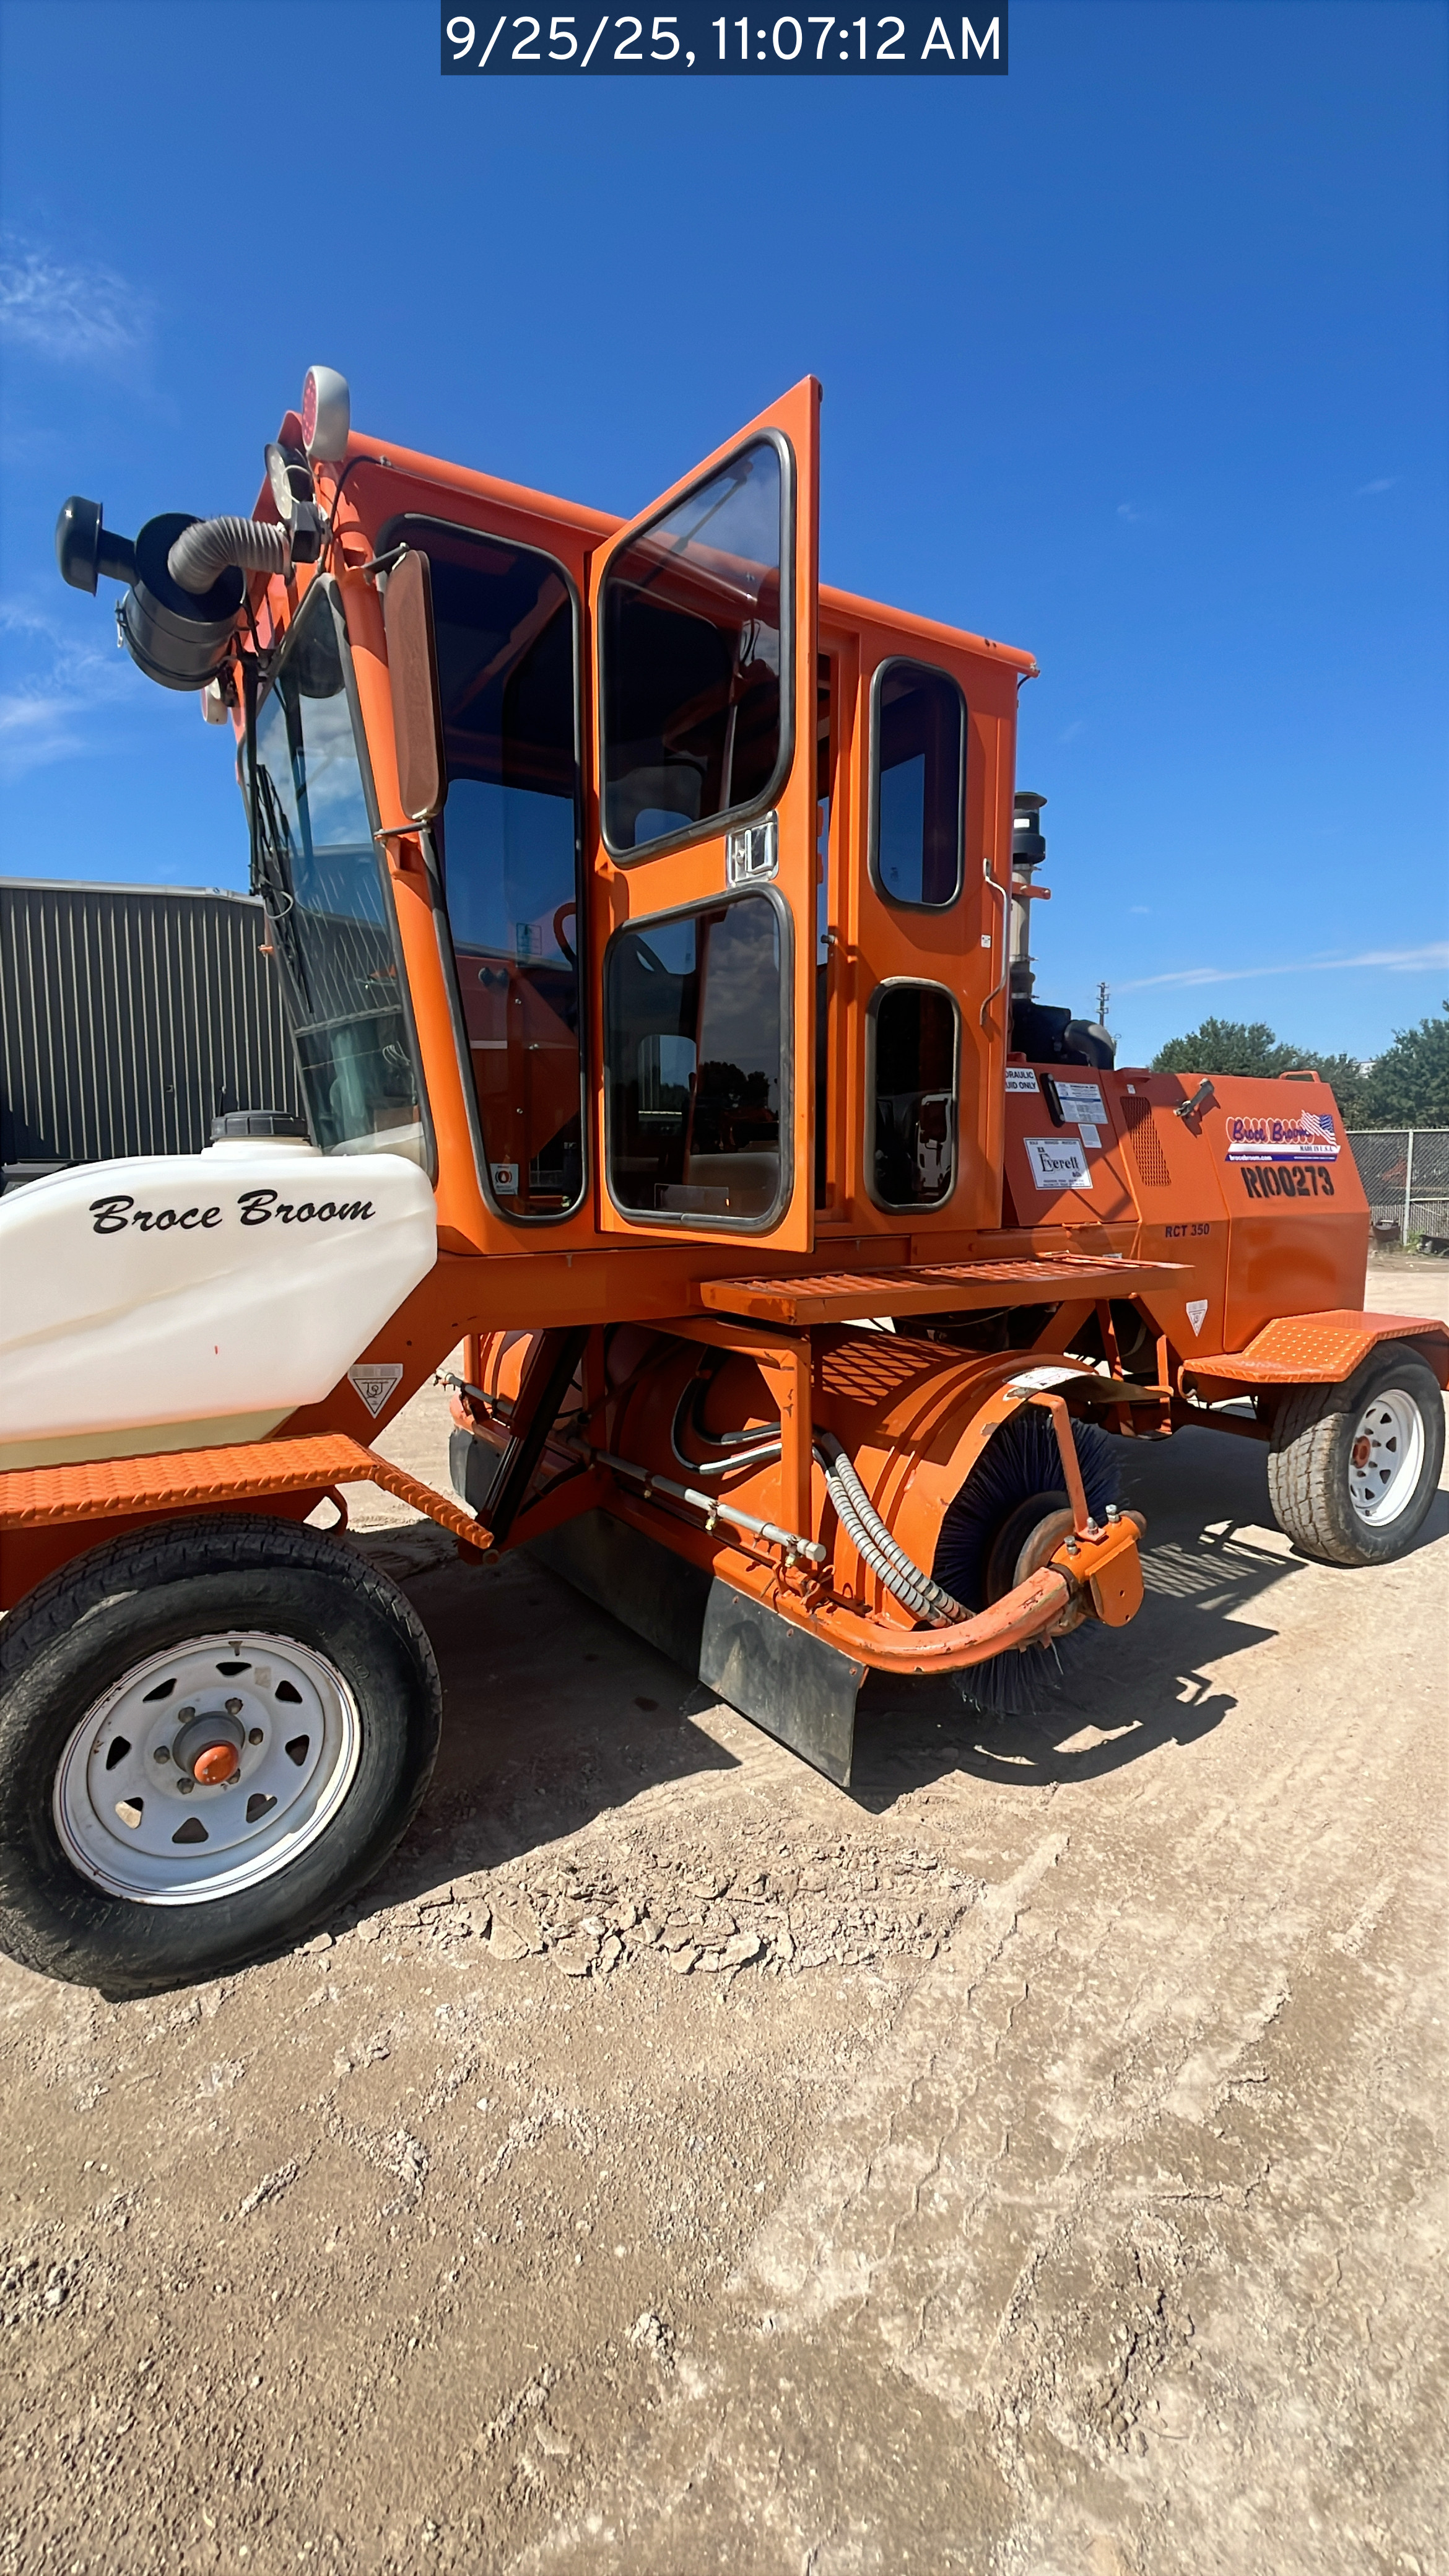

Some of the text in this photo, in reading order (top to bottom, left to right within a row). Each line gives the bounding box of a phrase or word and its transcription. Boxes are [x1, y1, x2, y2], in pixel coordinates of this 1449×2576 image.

[1006, 1071, 1033, 1079] DRAULIC
[1006, 1081, 1017, 1089] UID
[89, 1189, 376, 1235] Broce Broom
[1165, 1223, 1210, 1238] RCT 350
